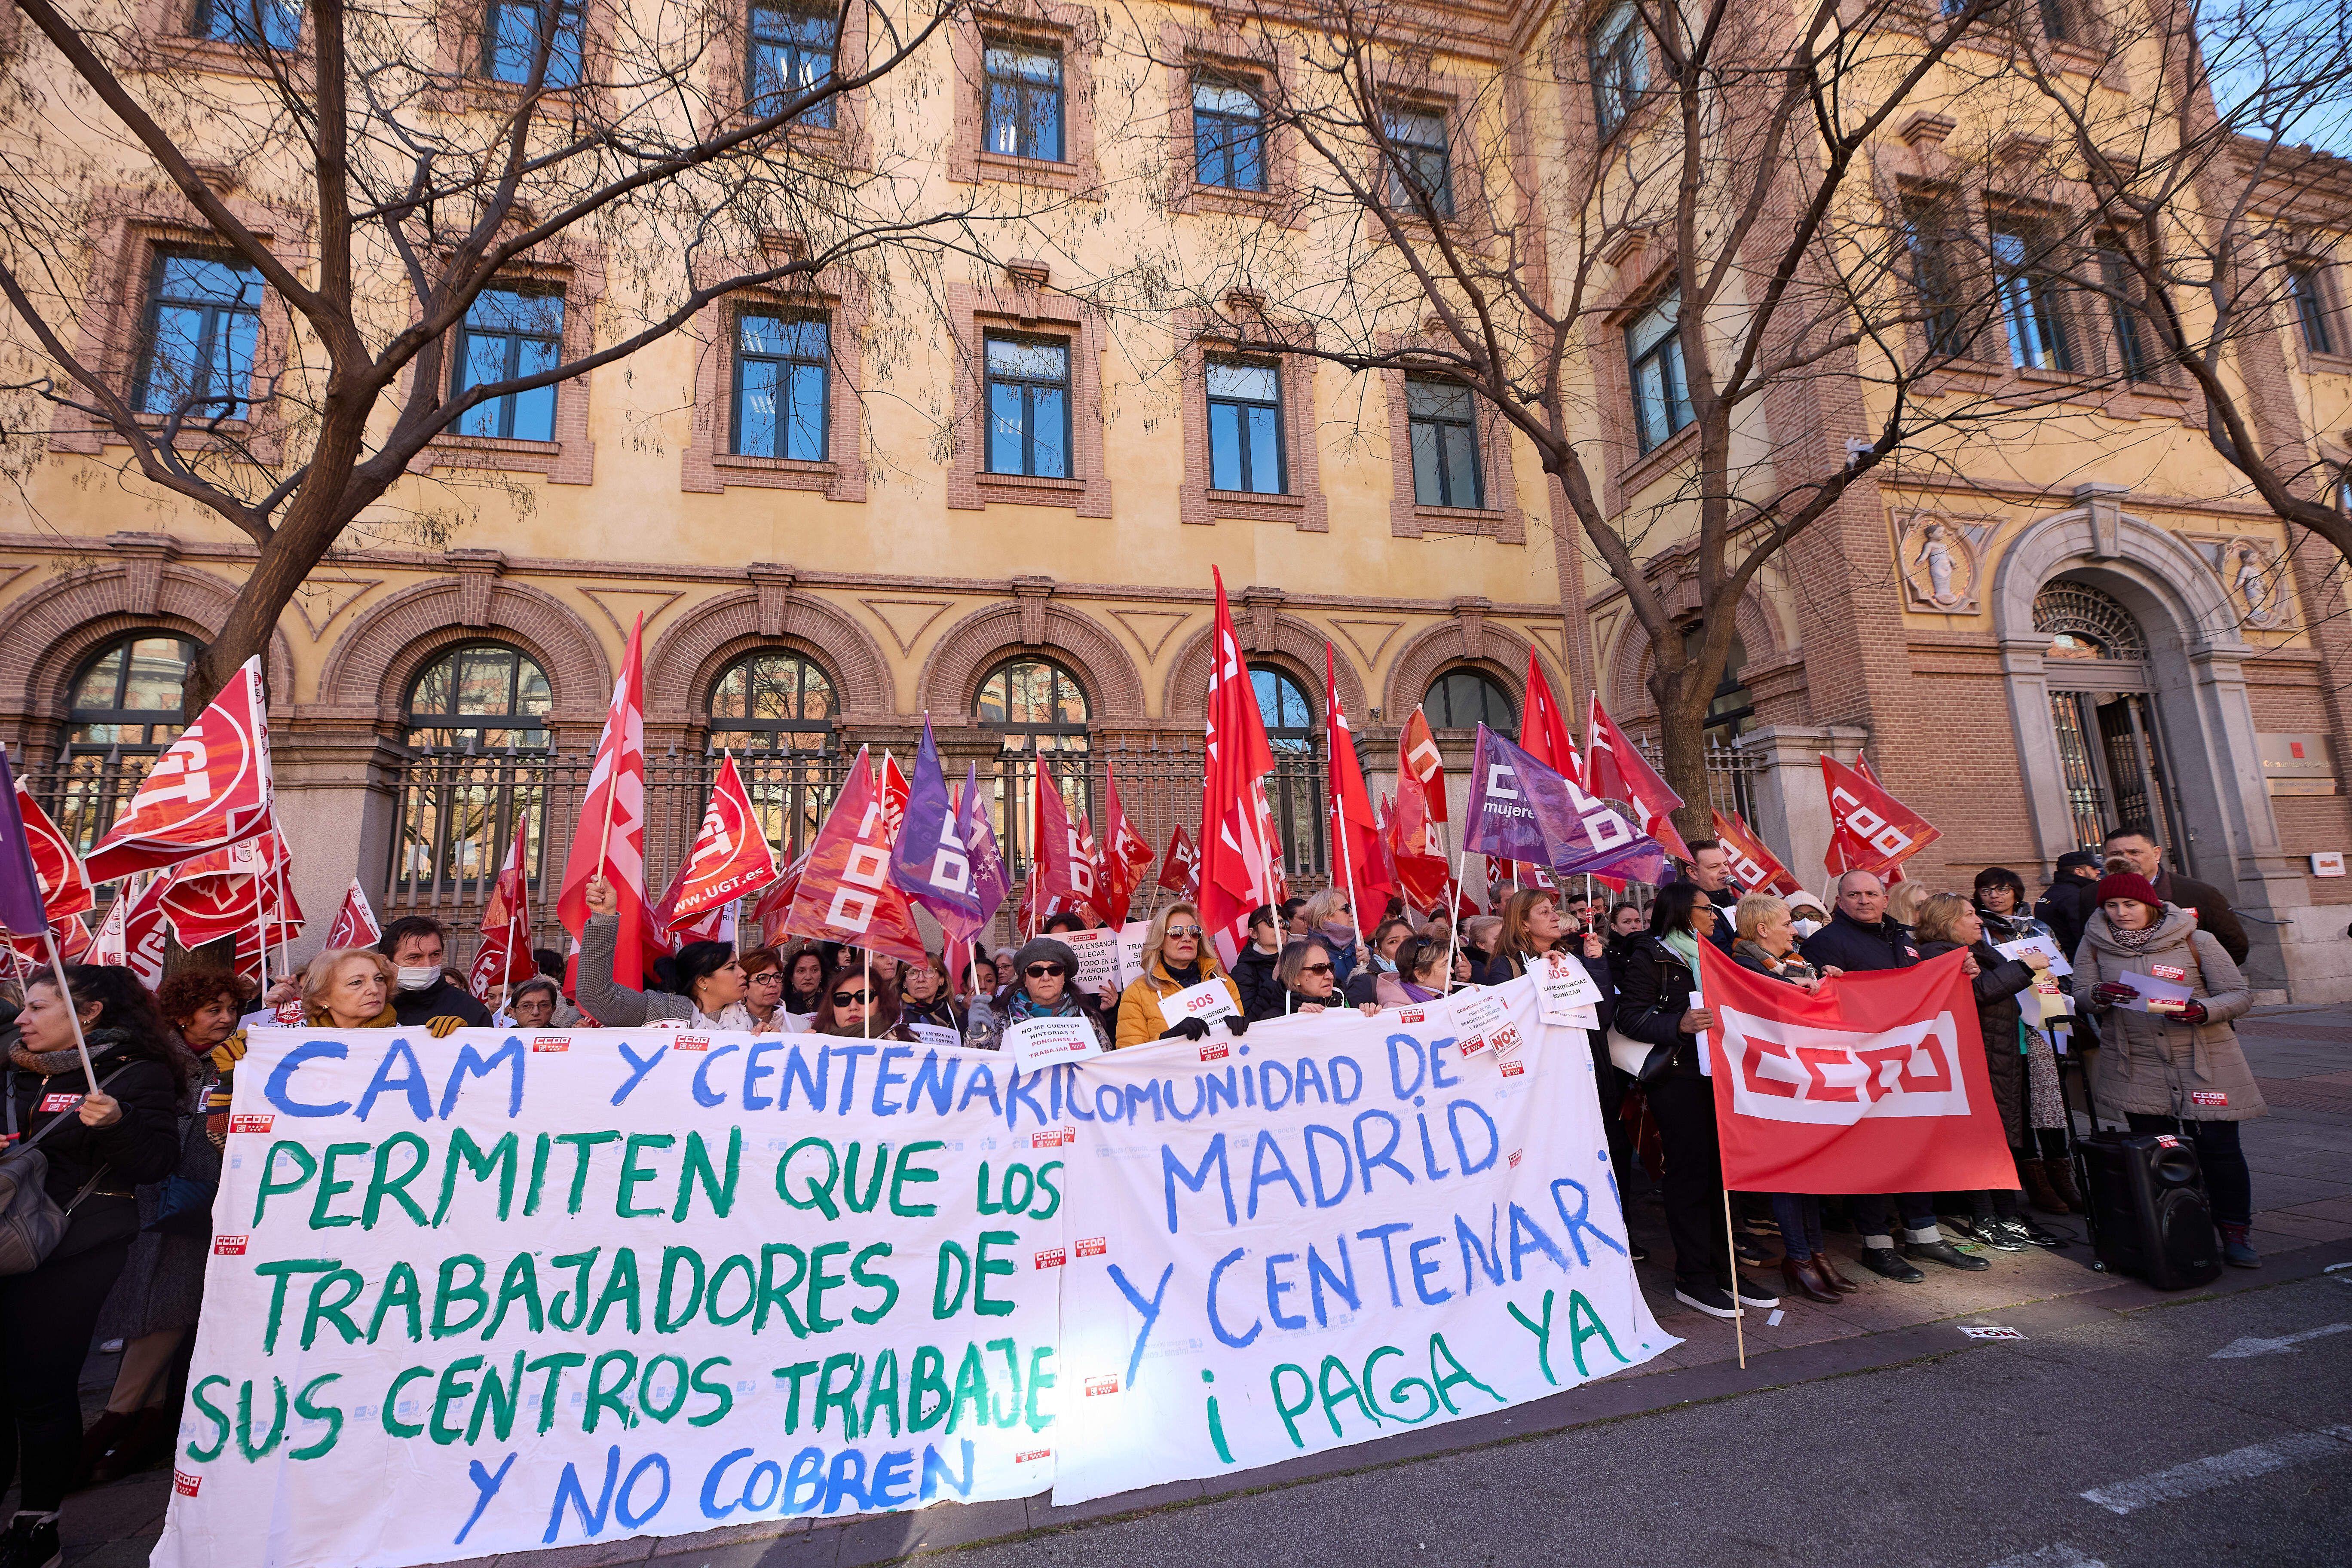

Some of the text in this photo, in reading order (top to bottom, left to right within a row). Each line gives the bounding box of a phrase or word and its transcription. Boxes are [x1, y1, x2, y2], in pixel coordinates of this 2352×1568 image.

[1483, 801, 1536, 819] mujere
[674, 867, 764, 913] ww.UGT.es
[1086, 940, 1118, 949] ENSANCHE
[1075, 950, 1106, 959] ALLECAS.
[2016, 946, 2042, 957] SOS
[1549, 967, 1570, 980] SOS
[2153, 965, 2184, 975] CCOO
[1552, 979, 1587, 990] RESIDENCIAS
[1553, 989, 1581, 999] AGONIZAN
[1186, 994, 1214, 1012] SOS
[1457, 1001, 1478, 1014] COMUNIDAD
[1199, 1005, 1230, 1020] ESIDENCIAS
[1485, 1007, 1501, 1017] USUARIOS
[1473, 1015, 1500, 1029] TRABAJADORES
[1030, 1031, 1069, 1039] HISTORIAS
[1032, 1038, 1071, 1047] PONGANSE
[1461, 1035, 1482, 1049] CCOO
[1497, 1038, 1520, 1055] PRECARIEDAD
[1029, 1047, 1069, 1059] TRABAJAR
[1201, 1043, 1226, 1054] CCOO
[1386, 1033, 1464, 1100] DE
[1500, 1061, 1522, 1070] CCOO
[264, 1035, 525, 1122] CAM
[611, 1042, 668, 1106] Y
[46, 1094, 83, 1103] CCO
[233, 1115, 272, 1124] CCOO
[1033, 1131, 1061, 1141] CCOO
[1162, 1095, 1498, 1234] MADRID
[252, 1125, 1064, 1230] PERMITEN QUE LOS
[216, 1237, 247, 1245] CCOO
[1076, 1238, 1104, 1248] CCOO
[1036, 1249, 1064, 1260] CCOO
[254, 1230, 1020, 1356] TRABAJADORES DE
[1107, 1262, 1173, 1391] Y
[1271, 1332, 1507, 1449] PAGA
[1507, 1289, 1650, 1386] YA
[185, 1337, 1057, 1464] SUS CENTROS TRABAJE
[453, 1439, 974, 1545] Y NO COBREN
